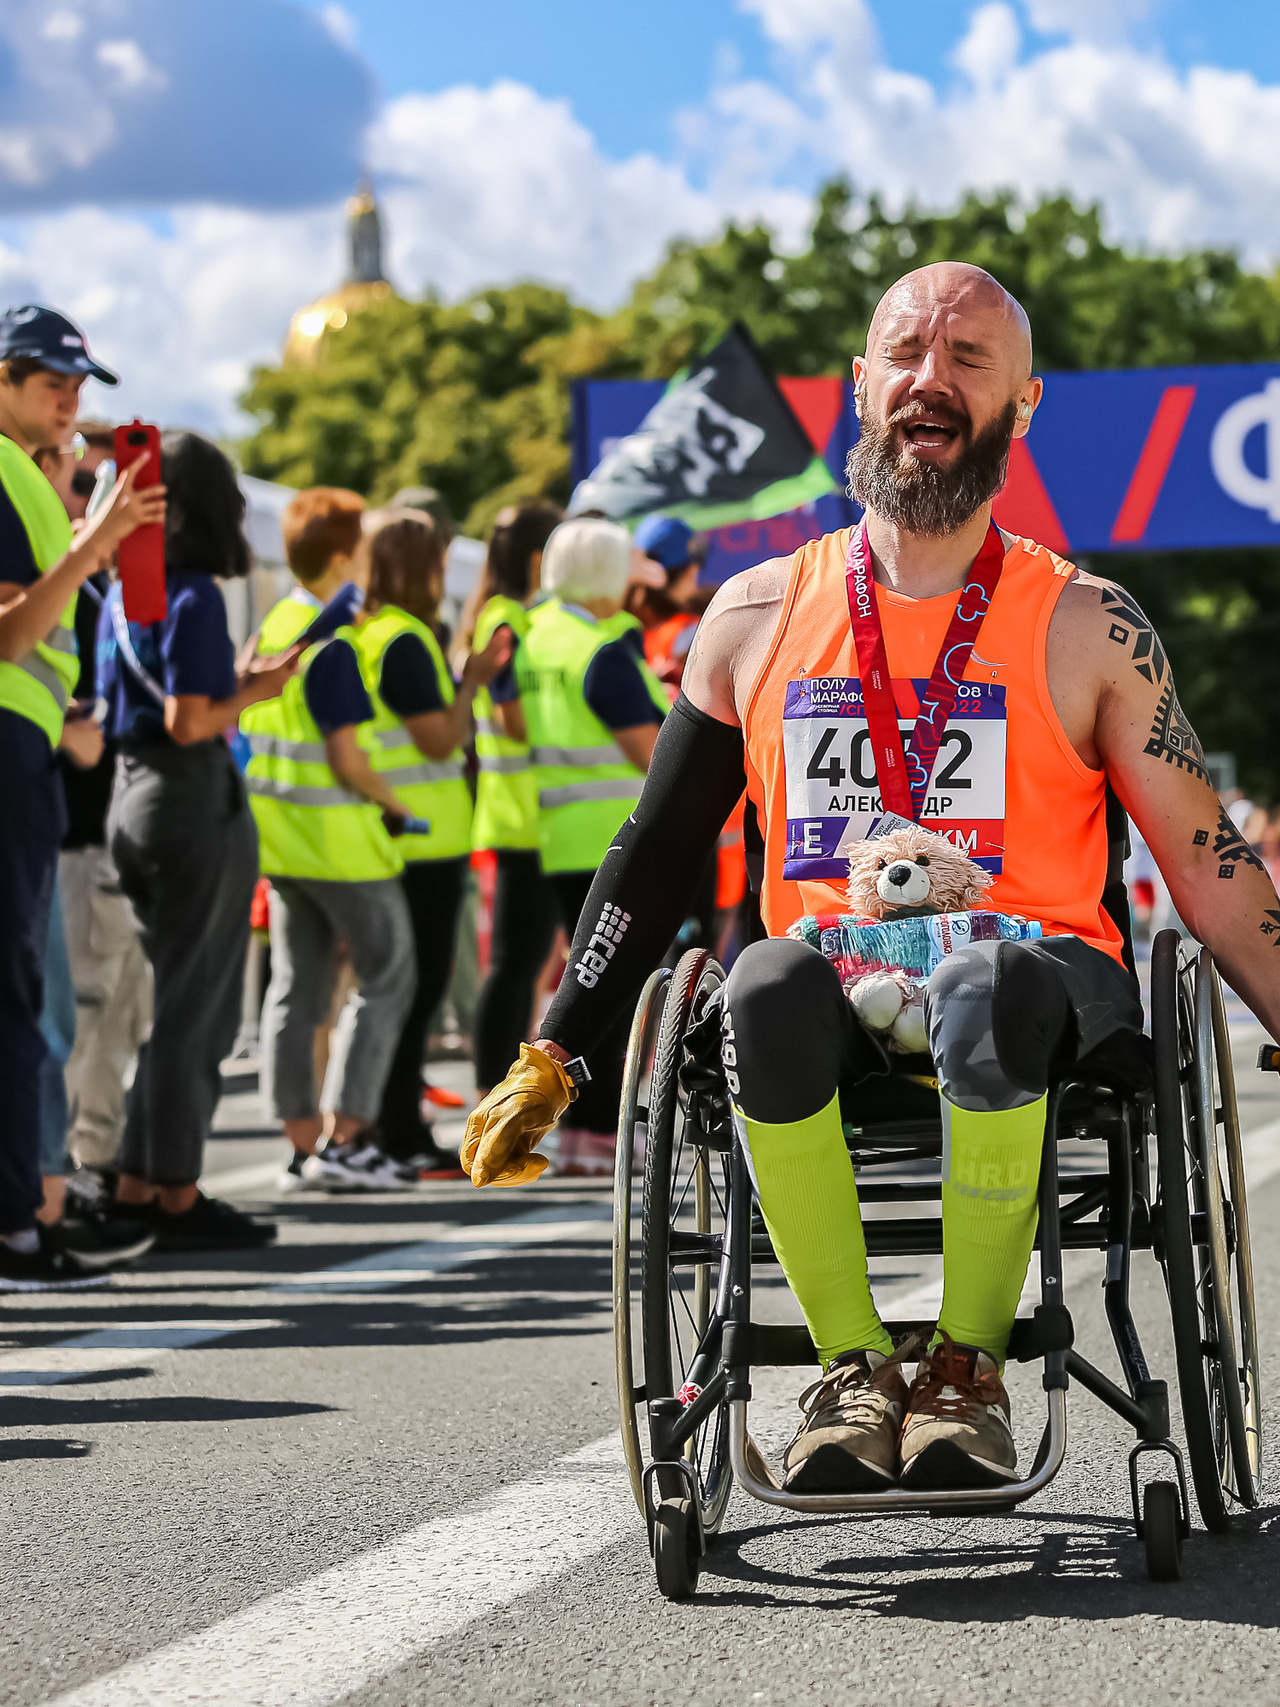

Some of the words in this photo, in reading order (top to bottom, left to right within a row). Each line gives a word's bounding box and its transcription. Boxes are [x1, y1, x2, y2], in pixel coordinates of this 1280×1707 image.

[810, 679, 848, 691] ПОЛУ
[810, 692, 865, 704] МАРАФО
[828, 796, 952, 816] АЛЕКДР
[957, 1159, 1028, 1188] HRD
